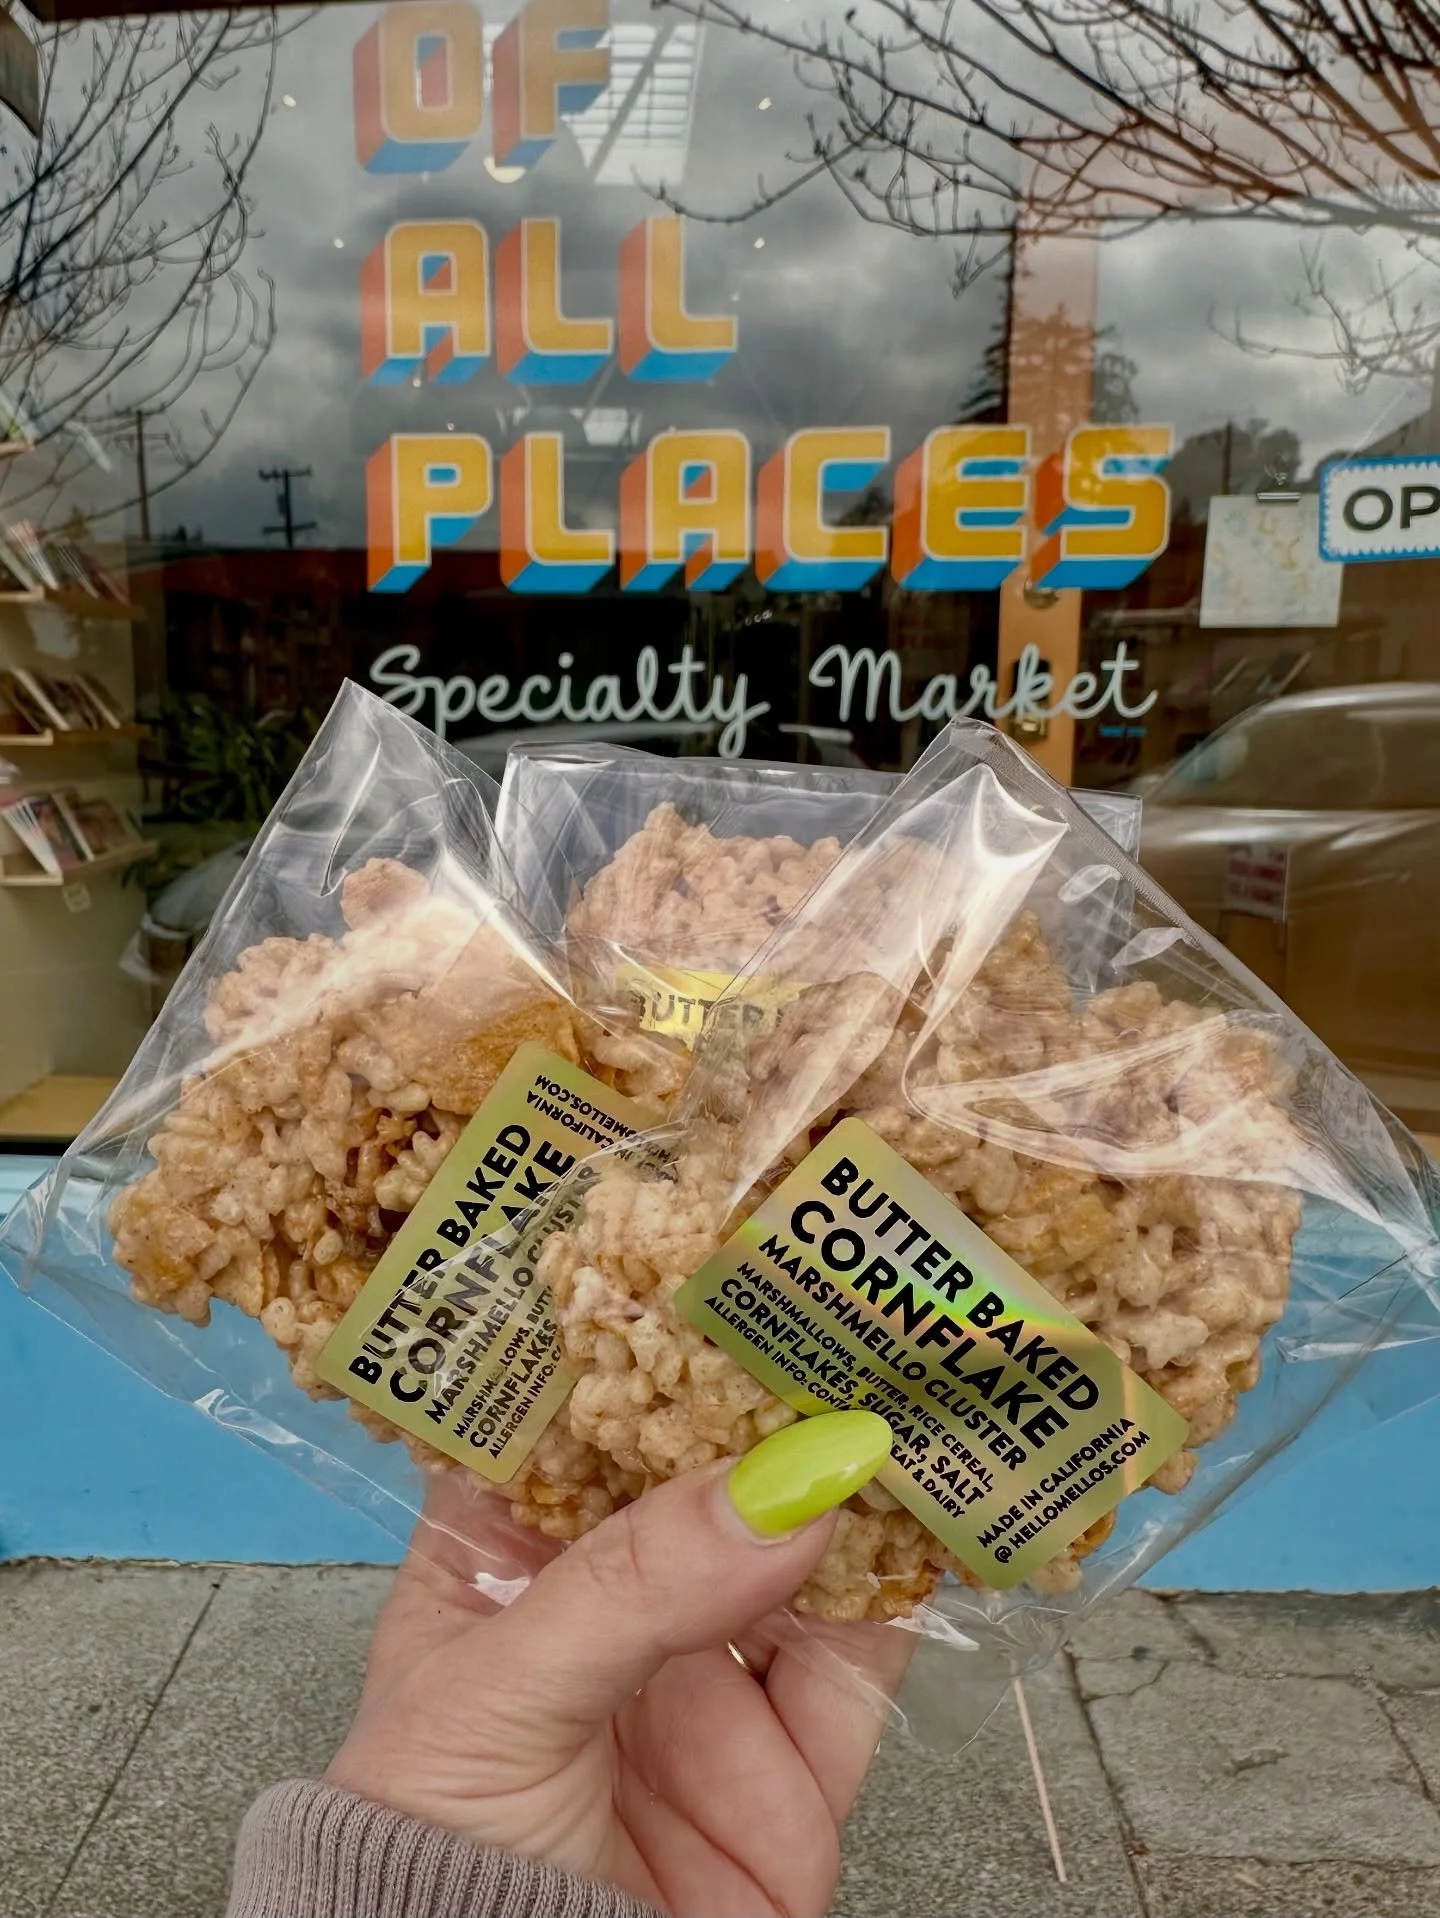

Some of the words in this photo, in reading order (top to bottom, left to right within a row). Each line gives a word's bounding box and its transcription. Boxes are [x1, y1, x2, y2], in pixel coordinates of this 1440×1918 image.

[353, 0, 611, 174] OF
[360, 216, 738, 386] ALL
[366, 424, 1174, 593] PLACES
[369, 643, 771, 758] Specialty
[808, 641, 1158, 722] Market
[526, 1090, 615, 1149] CALIFORNIA
[348, 1248, 455, 1385] BUTTER
[436, 1124, 531, 1248] BAKED
[389, 1141, 576, 1403] CORNFLAKE
[758, 1235, 927, 1381] MARSHMELLO
[924, 1379, 1027, 1471] CLUSTER
[791, 1201, 1069, 1449] CORNFLAKE
[821, 1157, 974, 1304] BUTTER
[966, 1292, 1099, 1411] BAKED
[704, 1296, 775, 1355] ALLERGEN
[771, 1350, 808, 1386] INFO:
[889, 1440, 917, 1470] EAT
[911, 1468, 926, 1483] &
[921, 1478, 966, 1519] DAIRY
[720, 1278, 859, 1400] CORNFLAKES,
[858, 1392, 931, 1464] SUGAR,
[930, 1455, 985, 1505] SALT
[737, 1262, 857, 1372] MARSHMALLOWS,
[856, 1366, 910, 1410] BUTTER,
[908, 1404, 946, 1436] RICE
[941, 1433, 994, 1492] CEREAL,
[976, 1505, 1025, 1549] MADE
[1019, 1489, 1044, 1511] IN
[1039, 1418, 1136, 1493] CALIFORNIA
[994, 1545, 1013, 1564] @
[1008, 1431, 1151, 1549] HELLOMELLOS.COM
